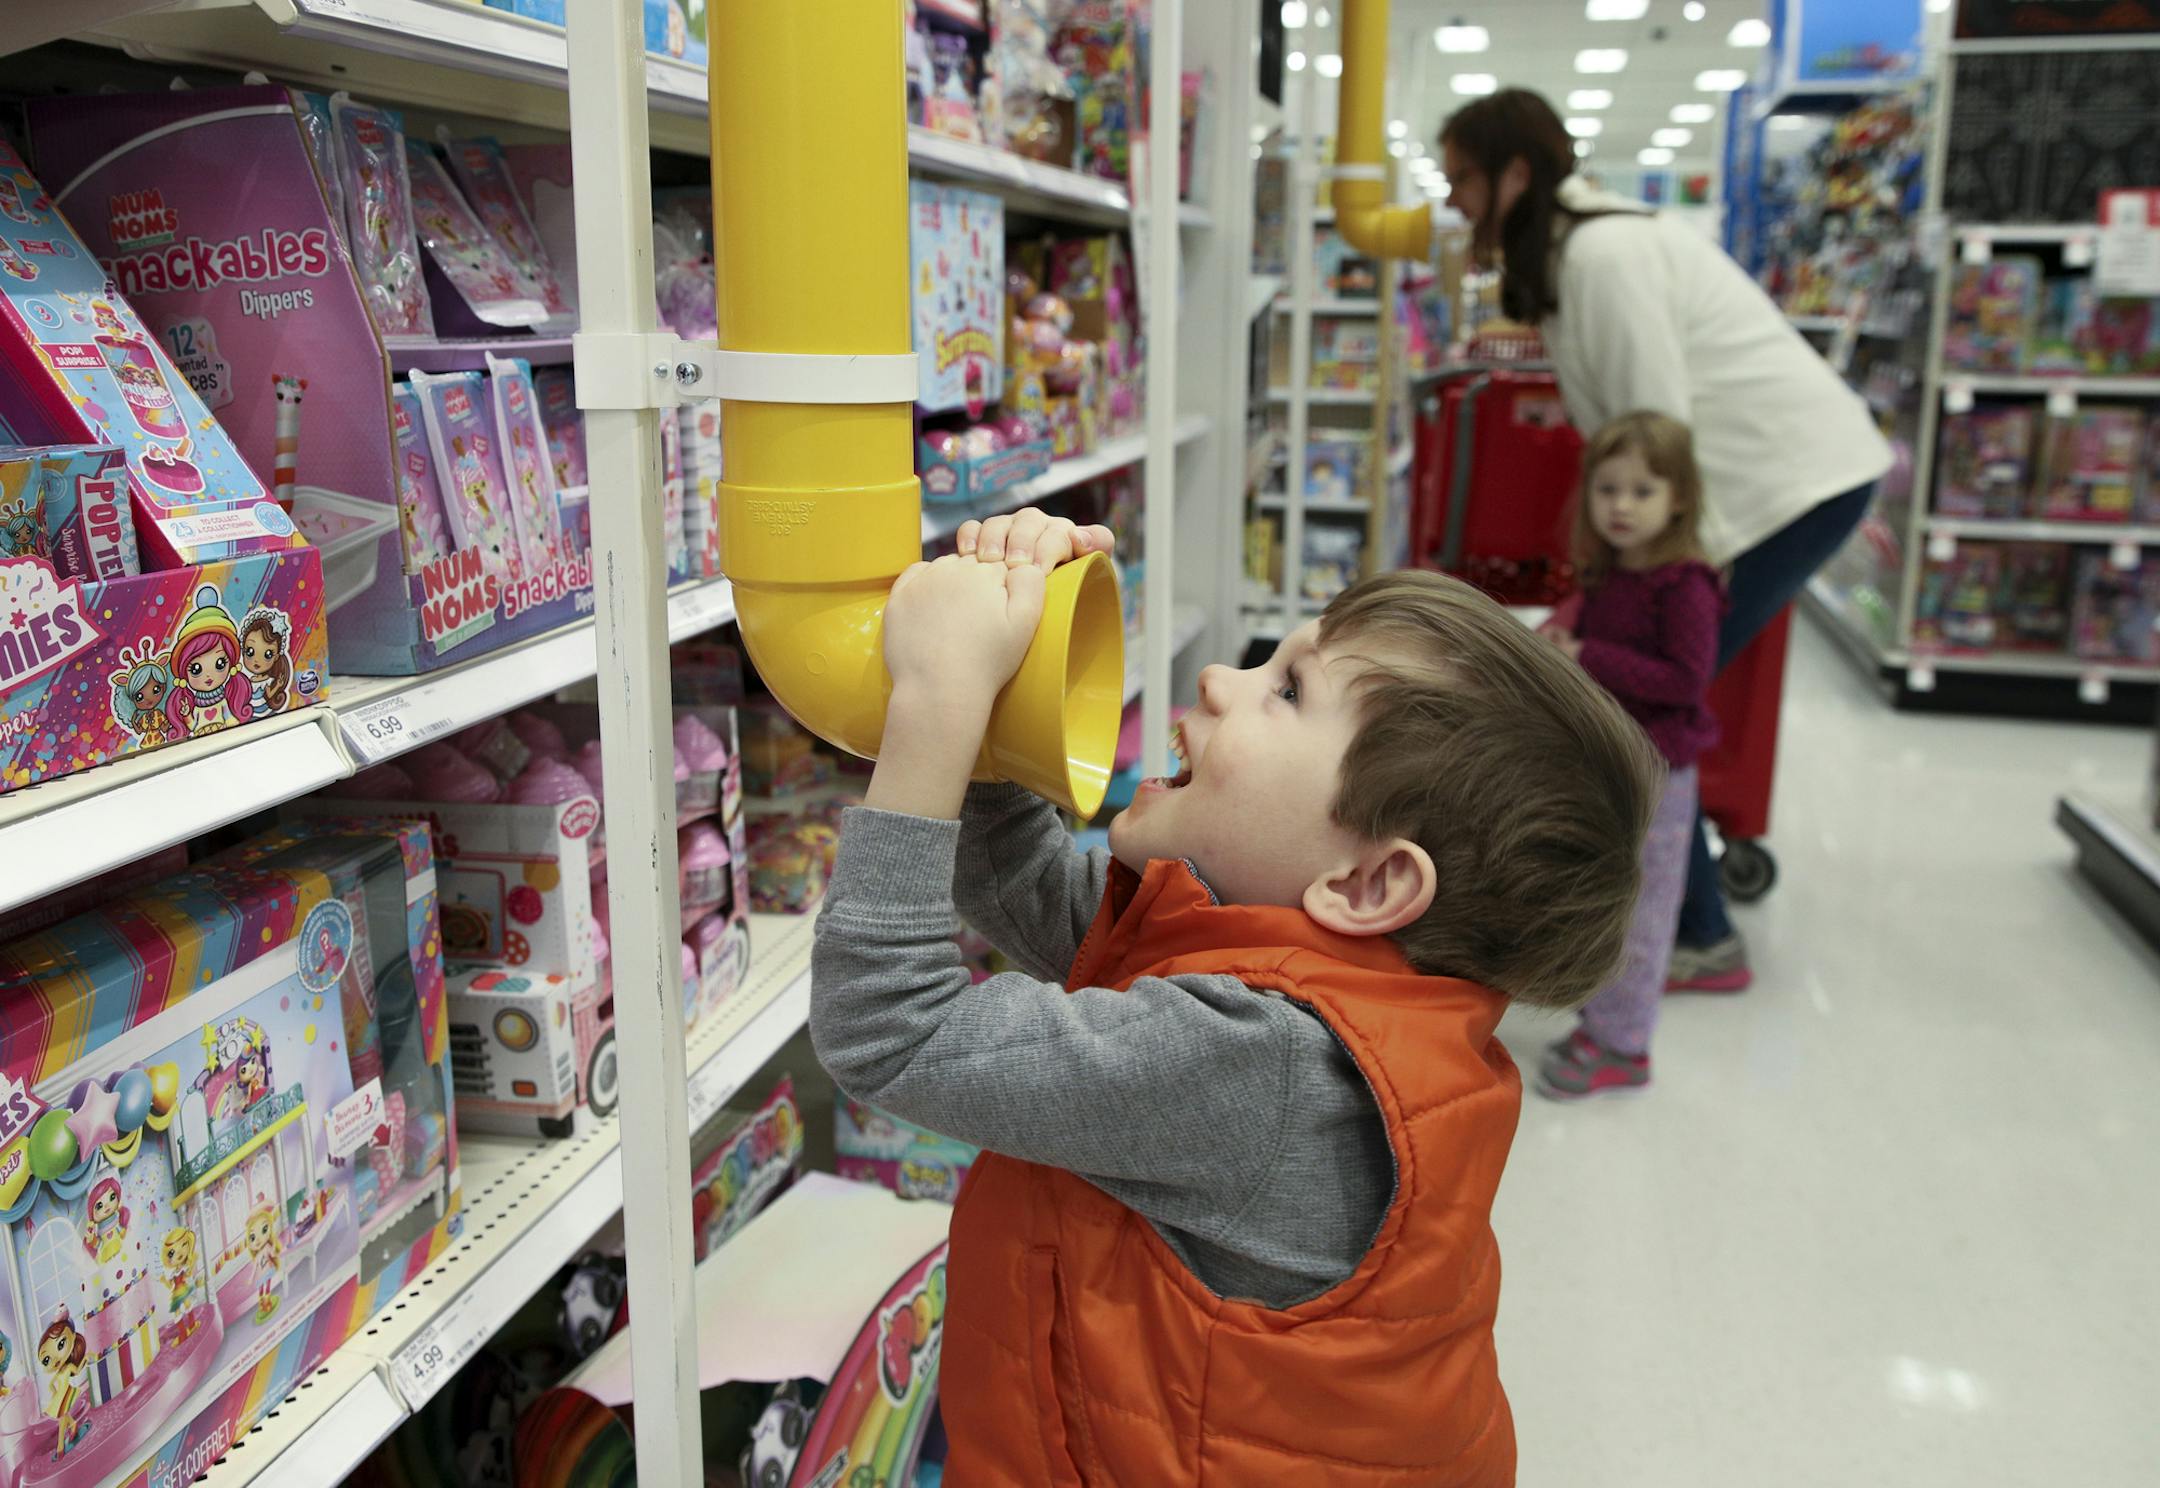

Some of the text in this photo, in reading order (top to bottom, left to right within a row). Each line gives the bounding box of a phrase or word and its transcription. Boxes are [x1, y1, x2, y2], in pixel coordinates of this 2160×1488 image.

[111, 188, 164, 219] NUM
[109, 209, 177, 240] NOMS
[240, 288, 313, 319] Dippers
[59, 346, 85, 356] POP!
[168, 324, 196, 357] 12
[188, 373, 218, 391] ces
[170, 521, 194, 537] 25
[752, 513, 808, 524] STYRENE
[62, 528, 79, 573] Surprise
[421, 545, 483, 599] NUM
[422, 574, 501, 639] NOMS
[367, 715, 402, 738] 6.99
[0, 1091, 29, 1142] ES
[414, 1345, 443, 1378] 4.99
